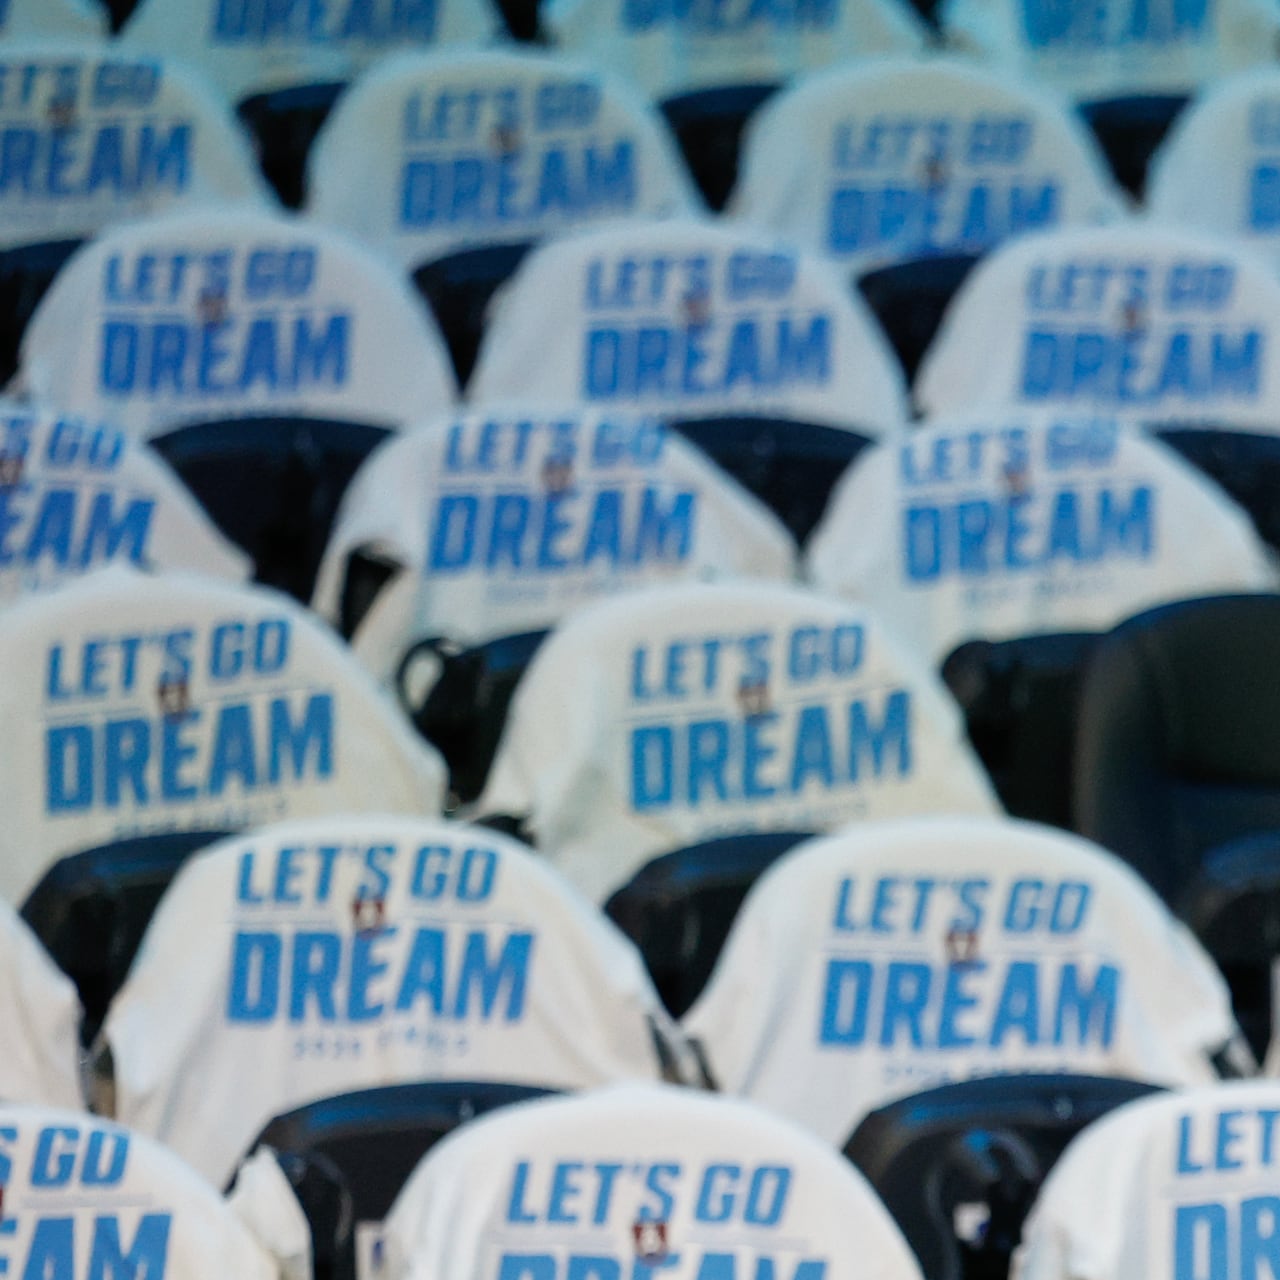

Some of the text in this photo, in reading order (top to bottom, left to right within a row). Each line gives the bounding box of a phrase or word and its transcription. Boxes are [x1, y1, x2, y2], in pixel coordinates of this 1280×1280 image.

[238, 846, 498, 902] LET'S GO
[835, 879, 1091, 932] LET'S GO
[227, 927, 533, 1022] DREAM
[820, 959, 1120, 1049] DREAM
[31, 1127, 130, 1187] GO
[507, 1162, 791, 1226] LET'S GO
